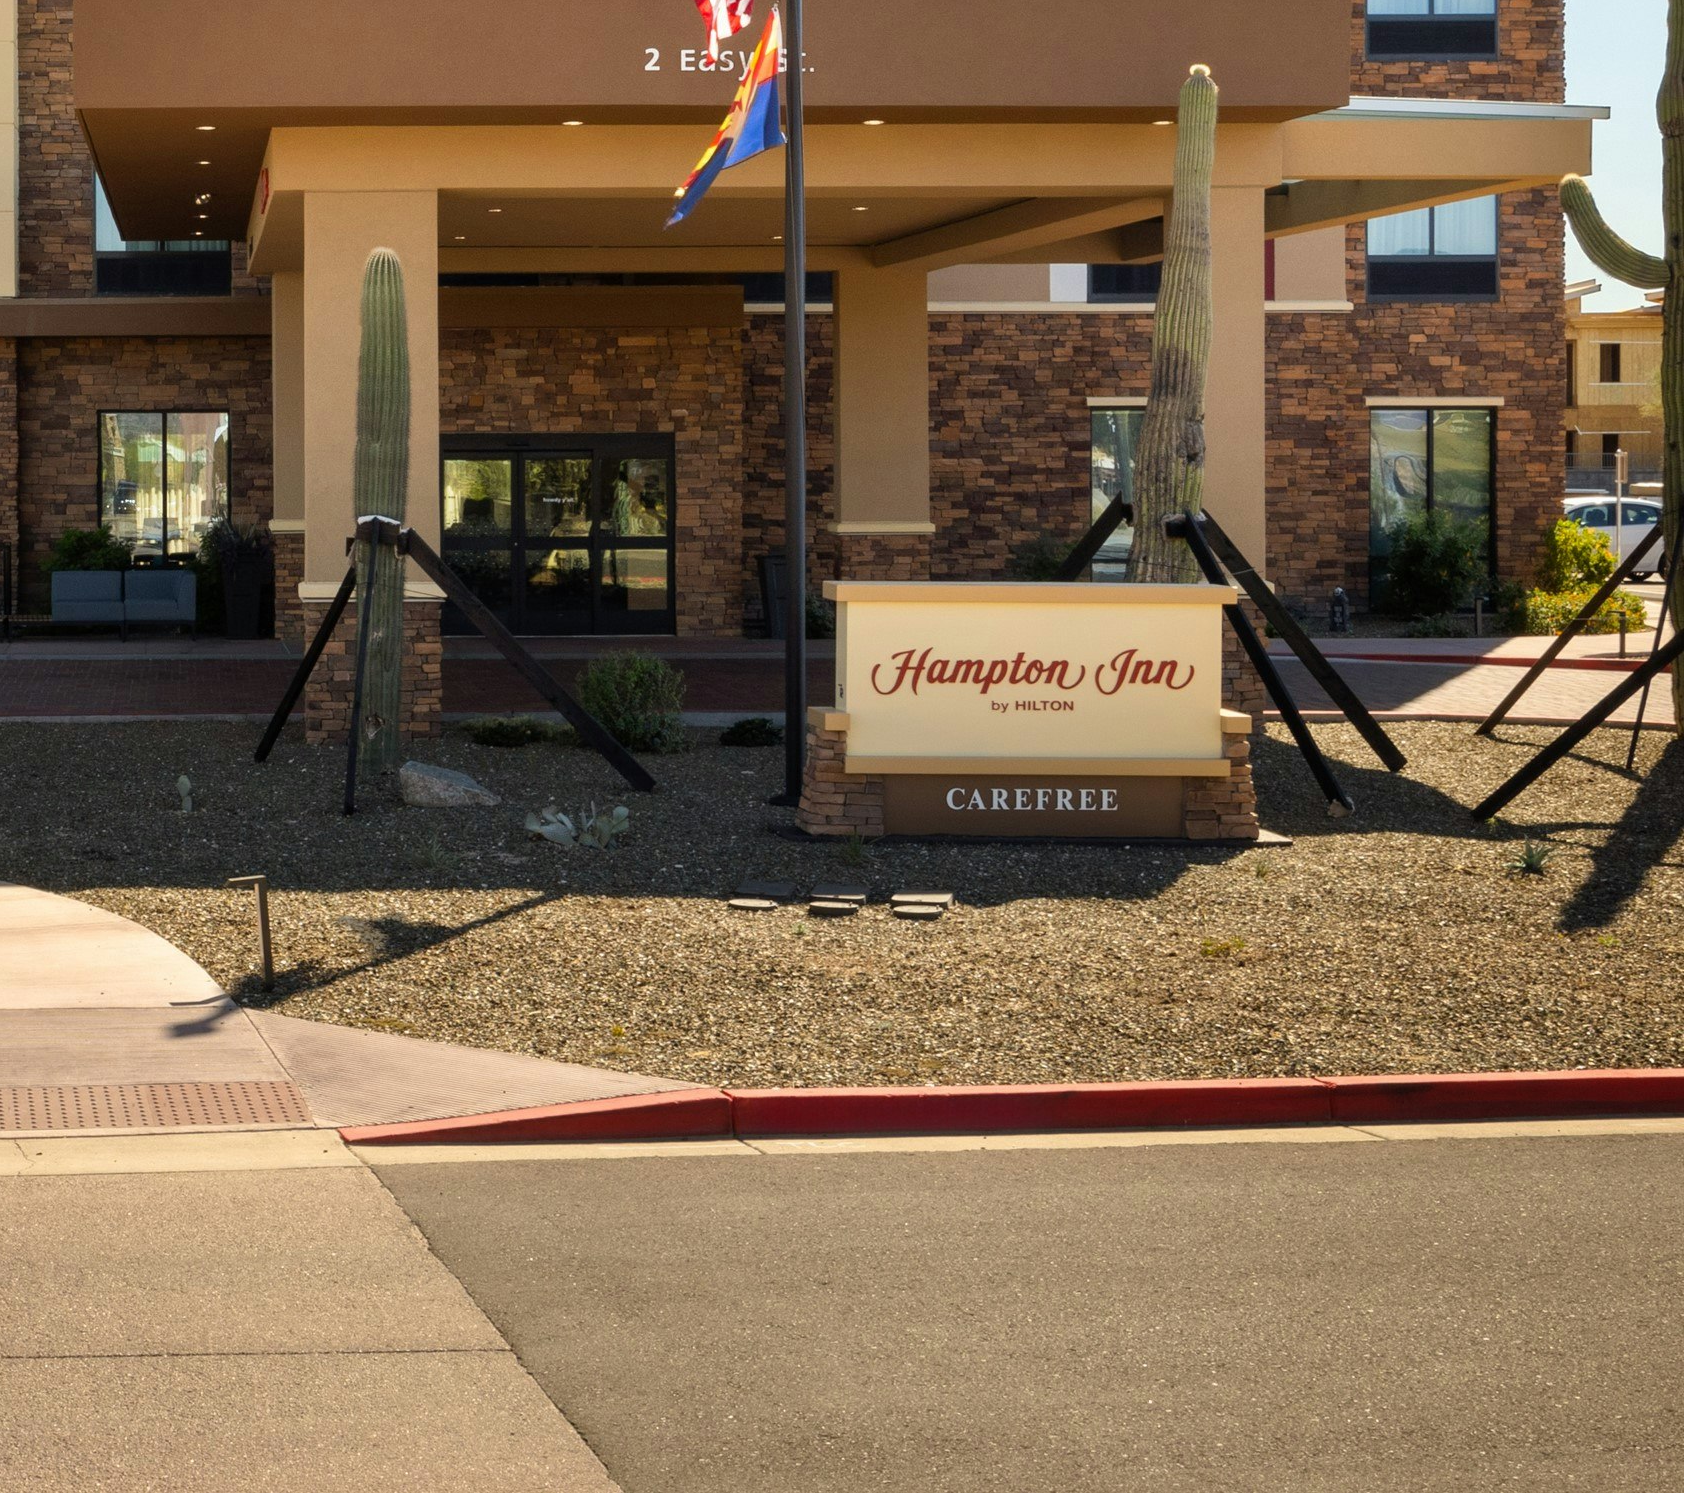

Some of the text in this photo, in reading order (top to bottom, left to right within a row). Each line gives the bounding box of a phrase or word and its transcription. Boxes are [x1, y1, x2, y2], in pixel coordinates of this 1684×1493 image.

[644, 47, 661, 72] 2
[871, 646, 1195, 696] Hampton Inn
[991, 700, 1074, 713] by HILTON
[946, 787, 1119, 811] CAREFREE
